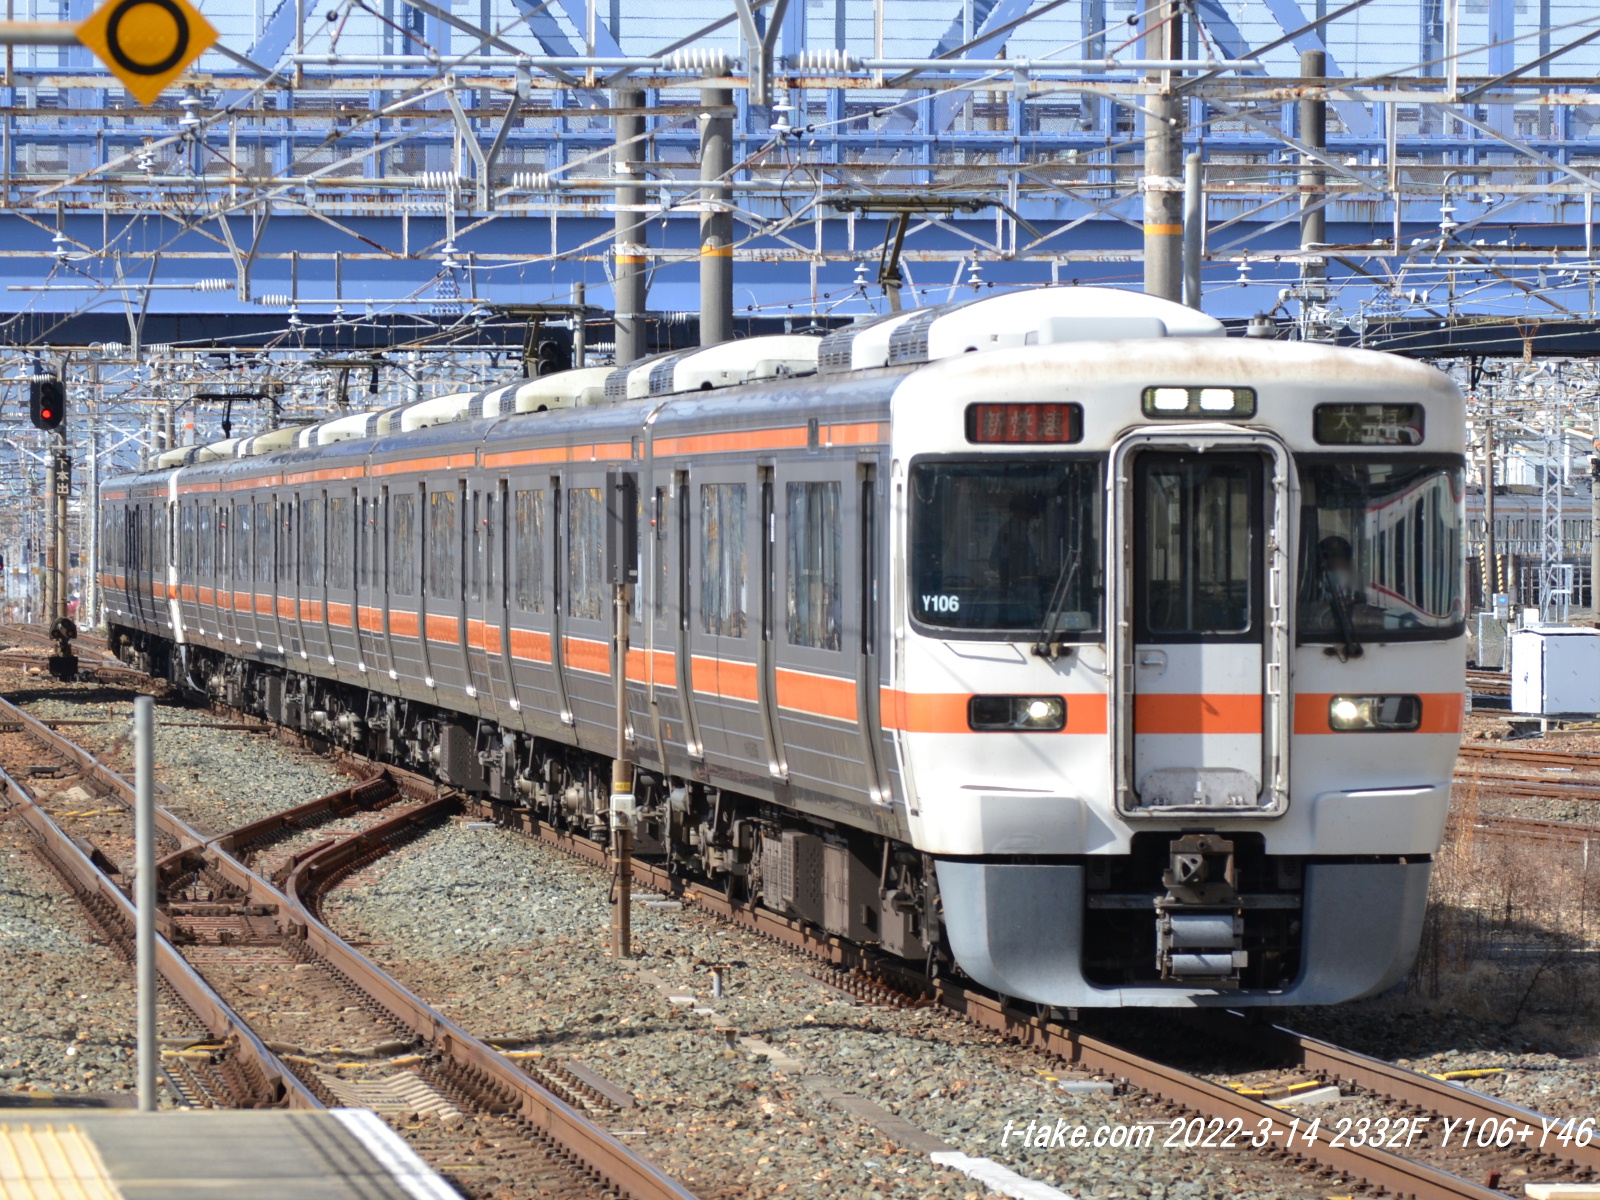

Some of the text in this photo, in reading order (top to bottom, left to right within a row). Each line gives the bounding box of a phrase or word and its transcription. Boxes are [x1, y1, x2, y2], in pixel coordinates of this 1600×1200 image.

[56, 457, 69, 494] 下本出
[922, 595, 960, 613] Y106
